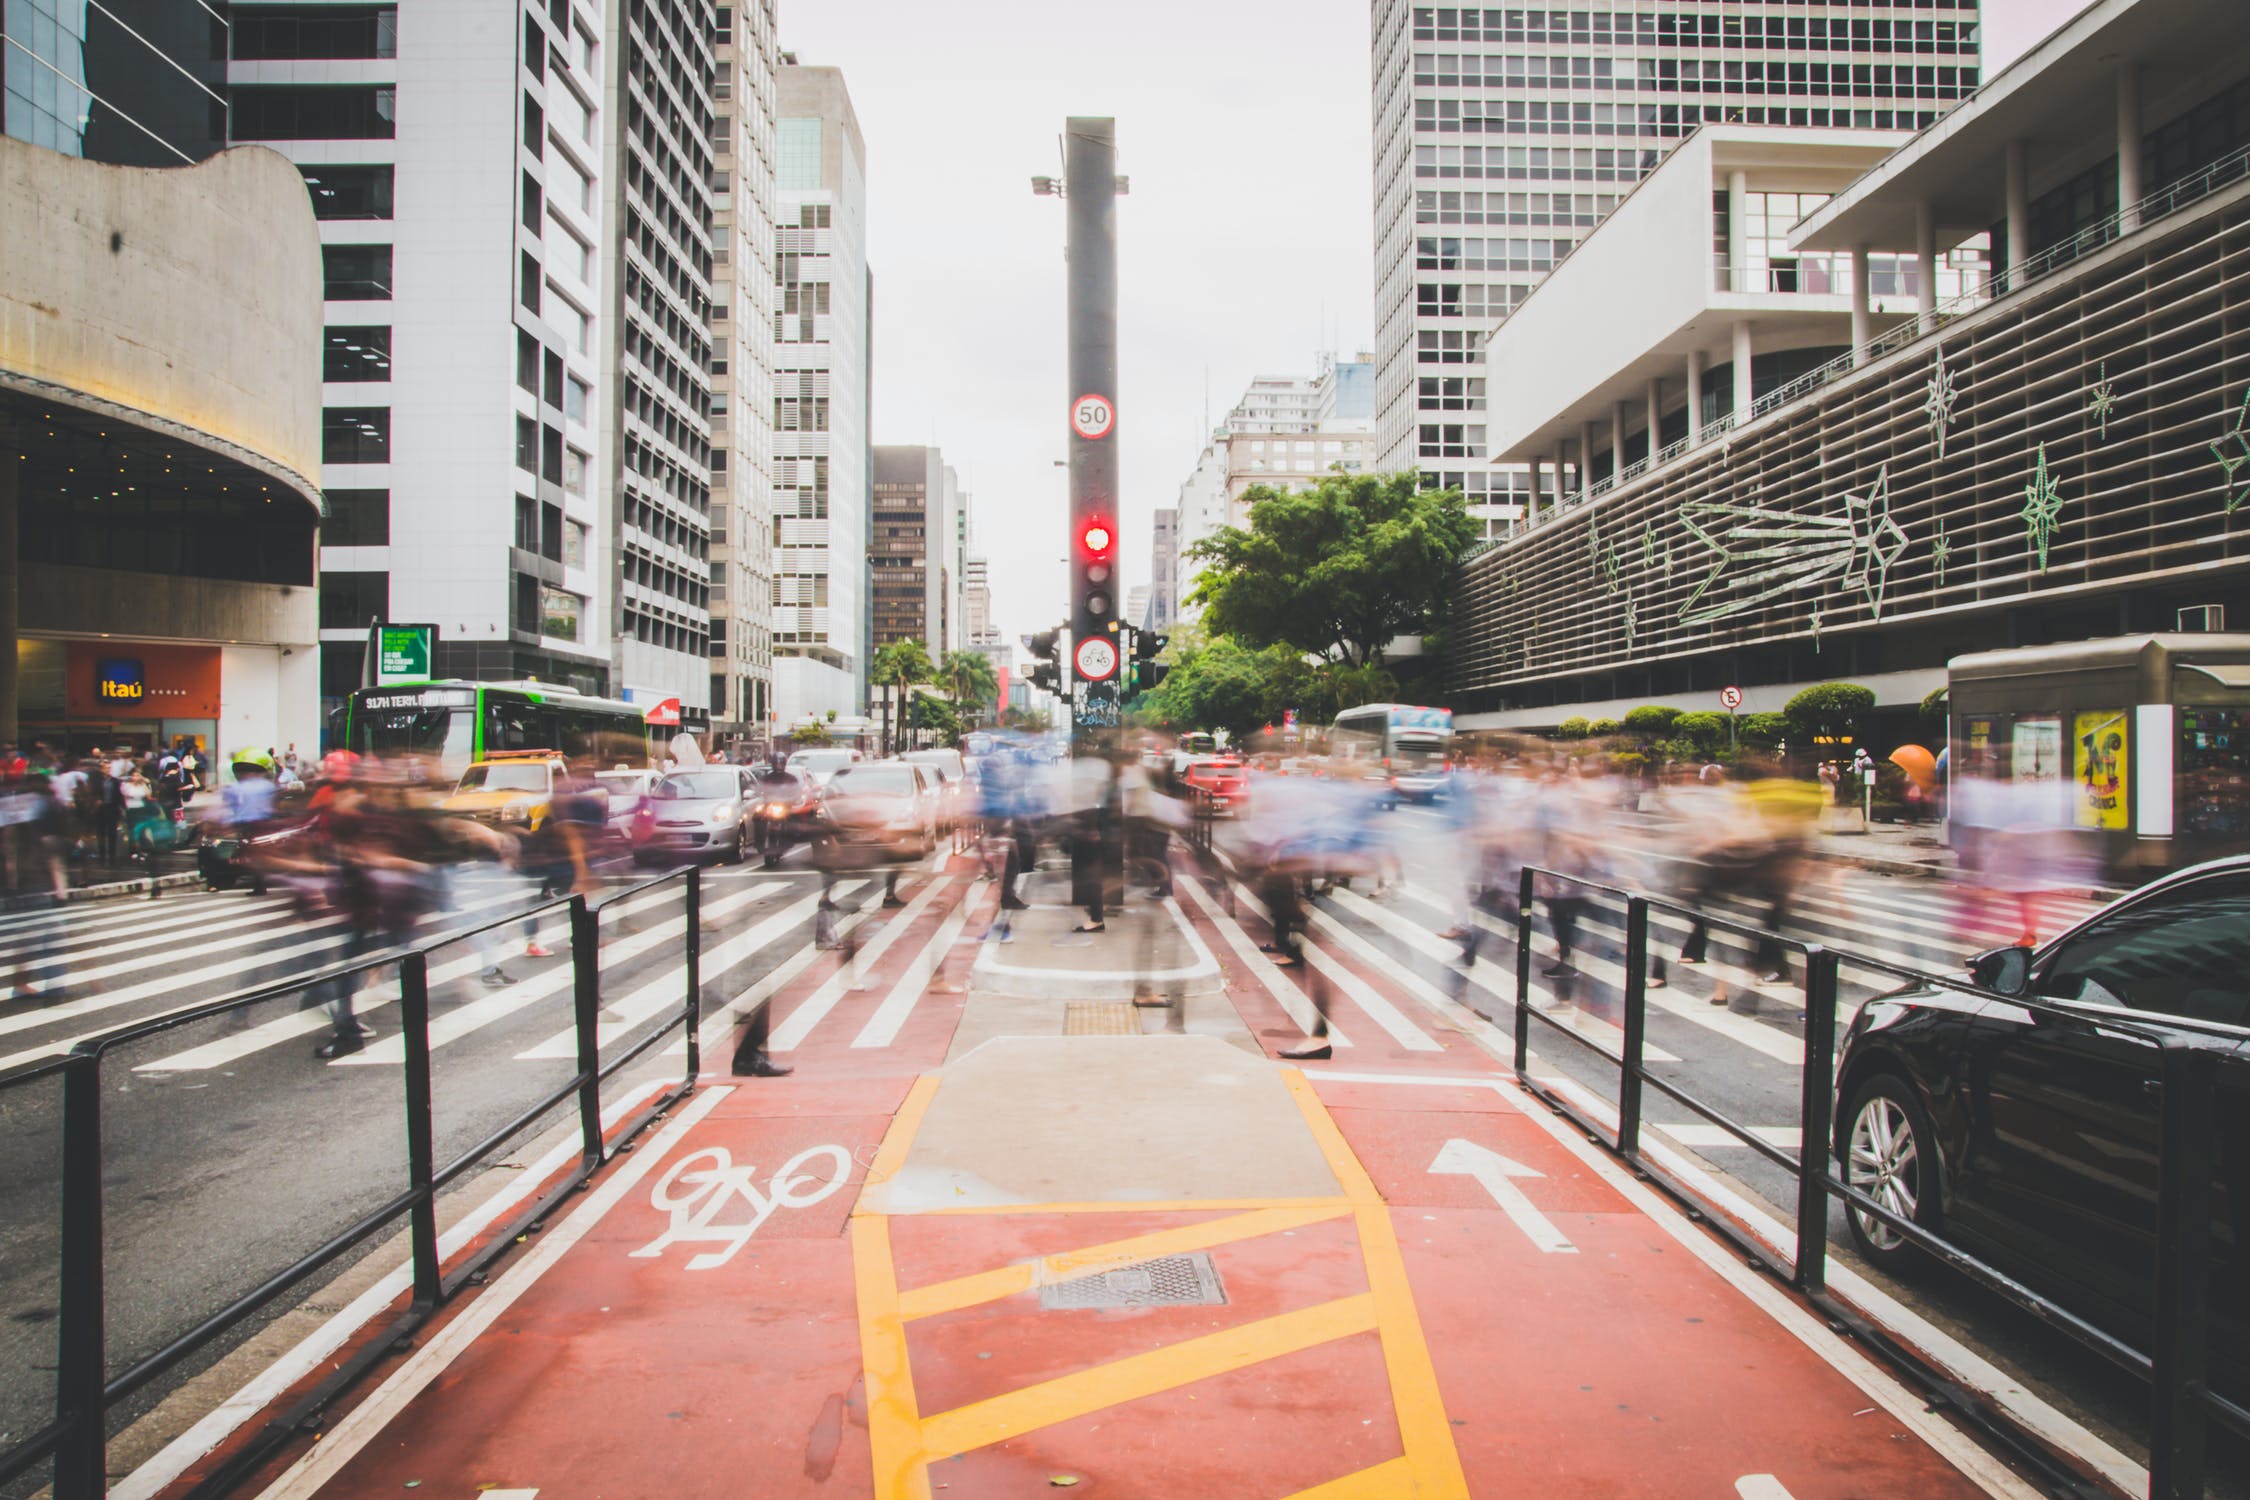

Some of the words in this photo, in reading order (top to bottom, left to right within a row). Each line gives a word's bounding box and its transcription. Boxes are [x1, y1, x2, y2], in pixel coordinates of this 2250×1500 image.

[1080, 406, 1107, 424] 50
[102, 680, 142, 697] Itaú
[366, 697, 390, 709] 917H
